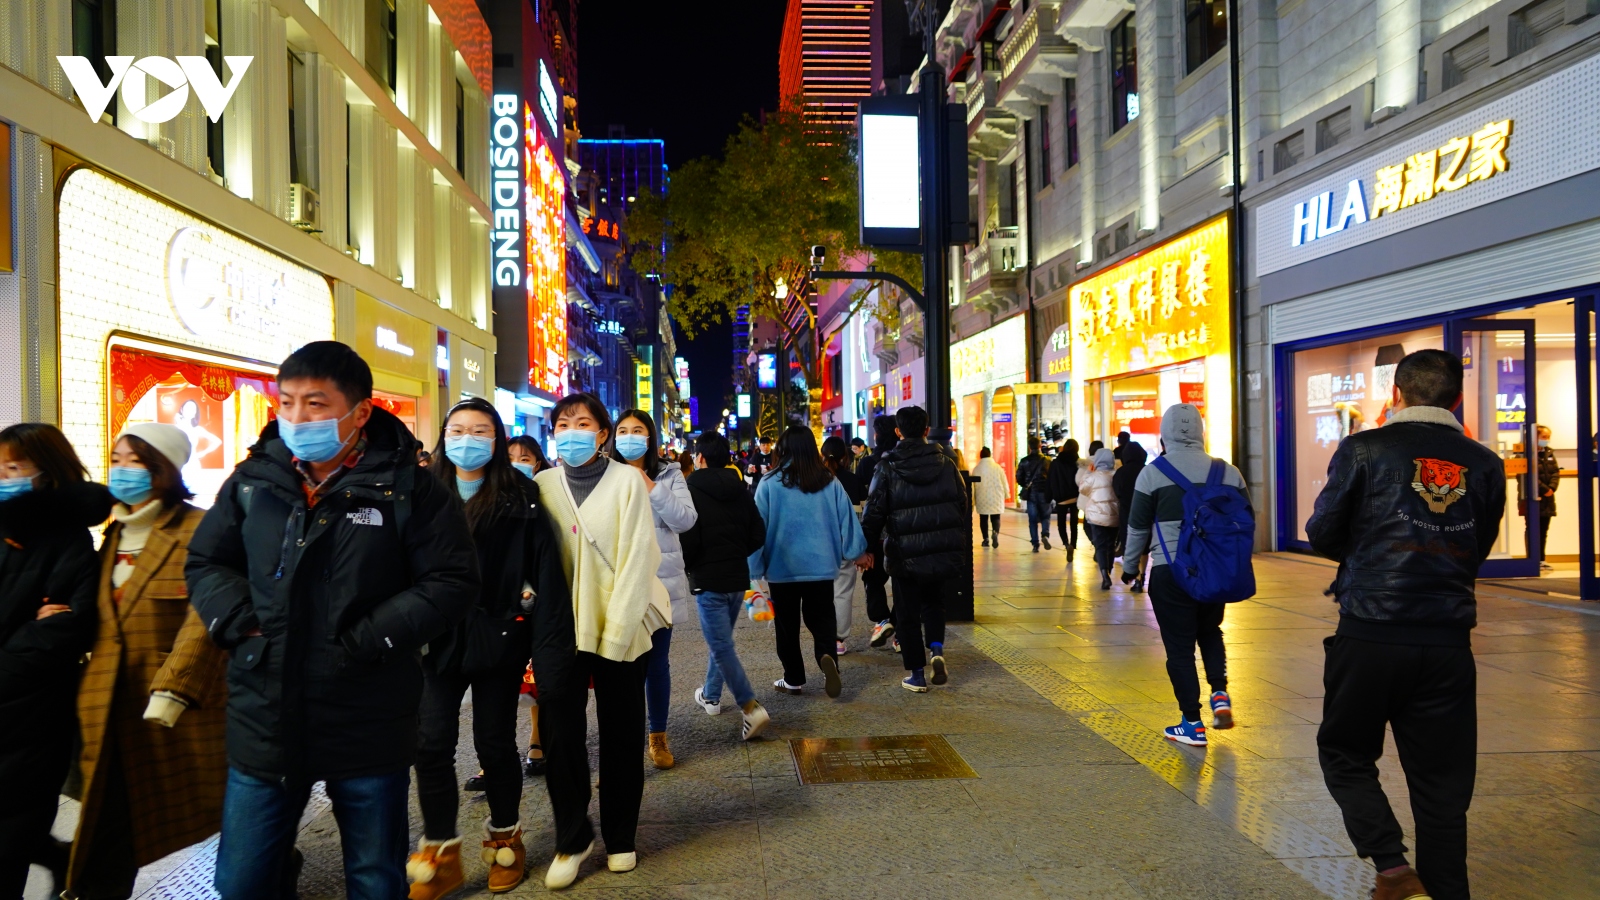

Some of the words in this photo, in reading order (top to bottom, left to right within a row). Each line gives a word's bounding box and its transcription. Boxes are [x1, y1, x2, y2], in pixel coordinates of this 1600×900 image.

[493, 94, 521, 286] BOSIDENG
[1291, 178, 1368, 247] HLA
[1370, 118, 1513, 220] 海澜之家
[1412, 519, 1440, 531] HOSTES
